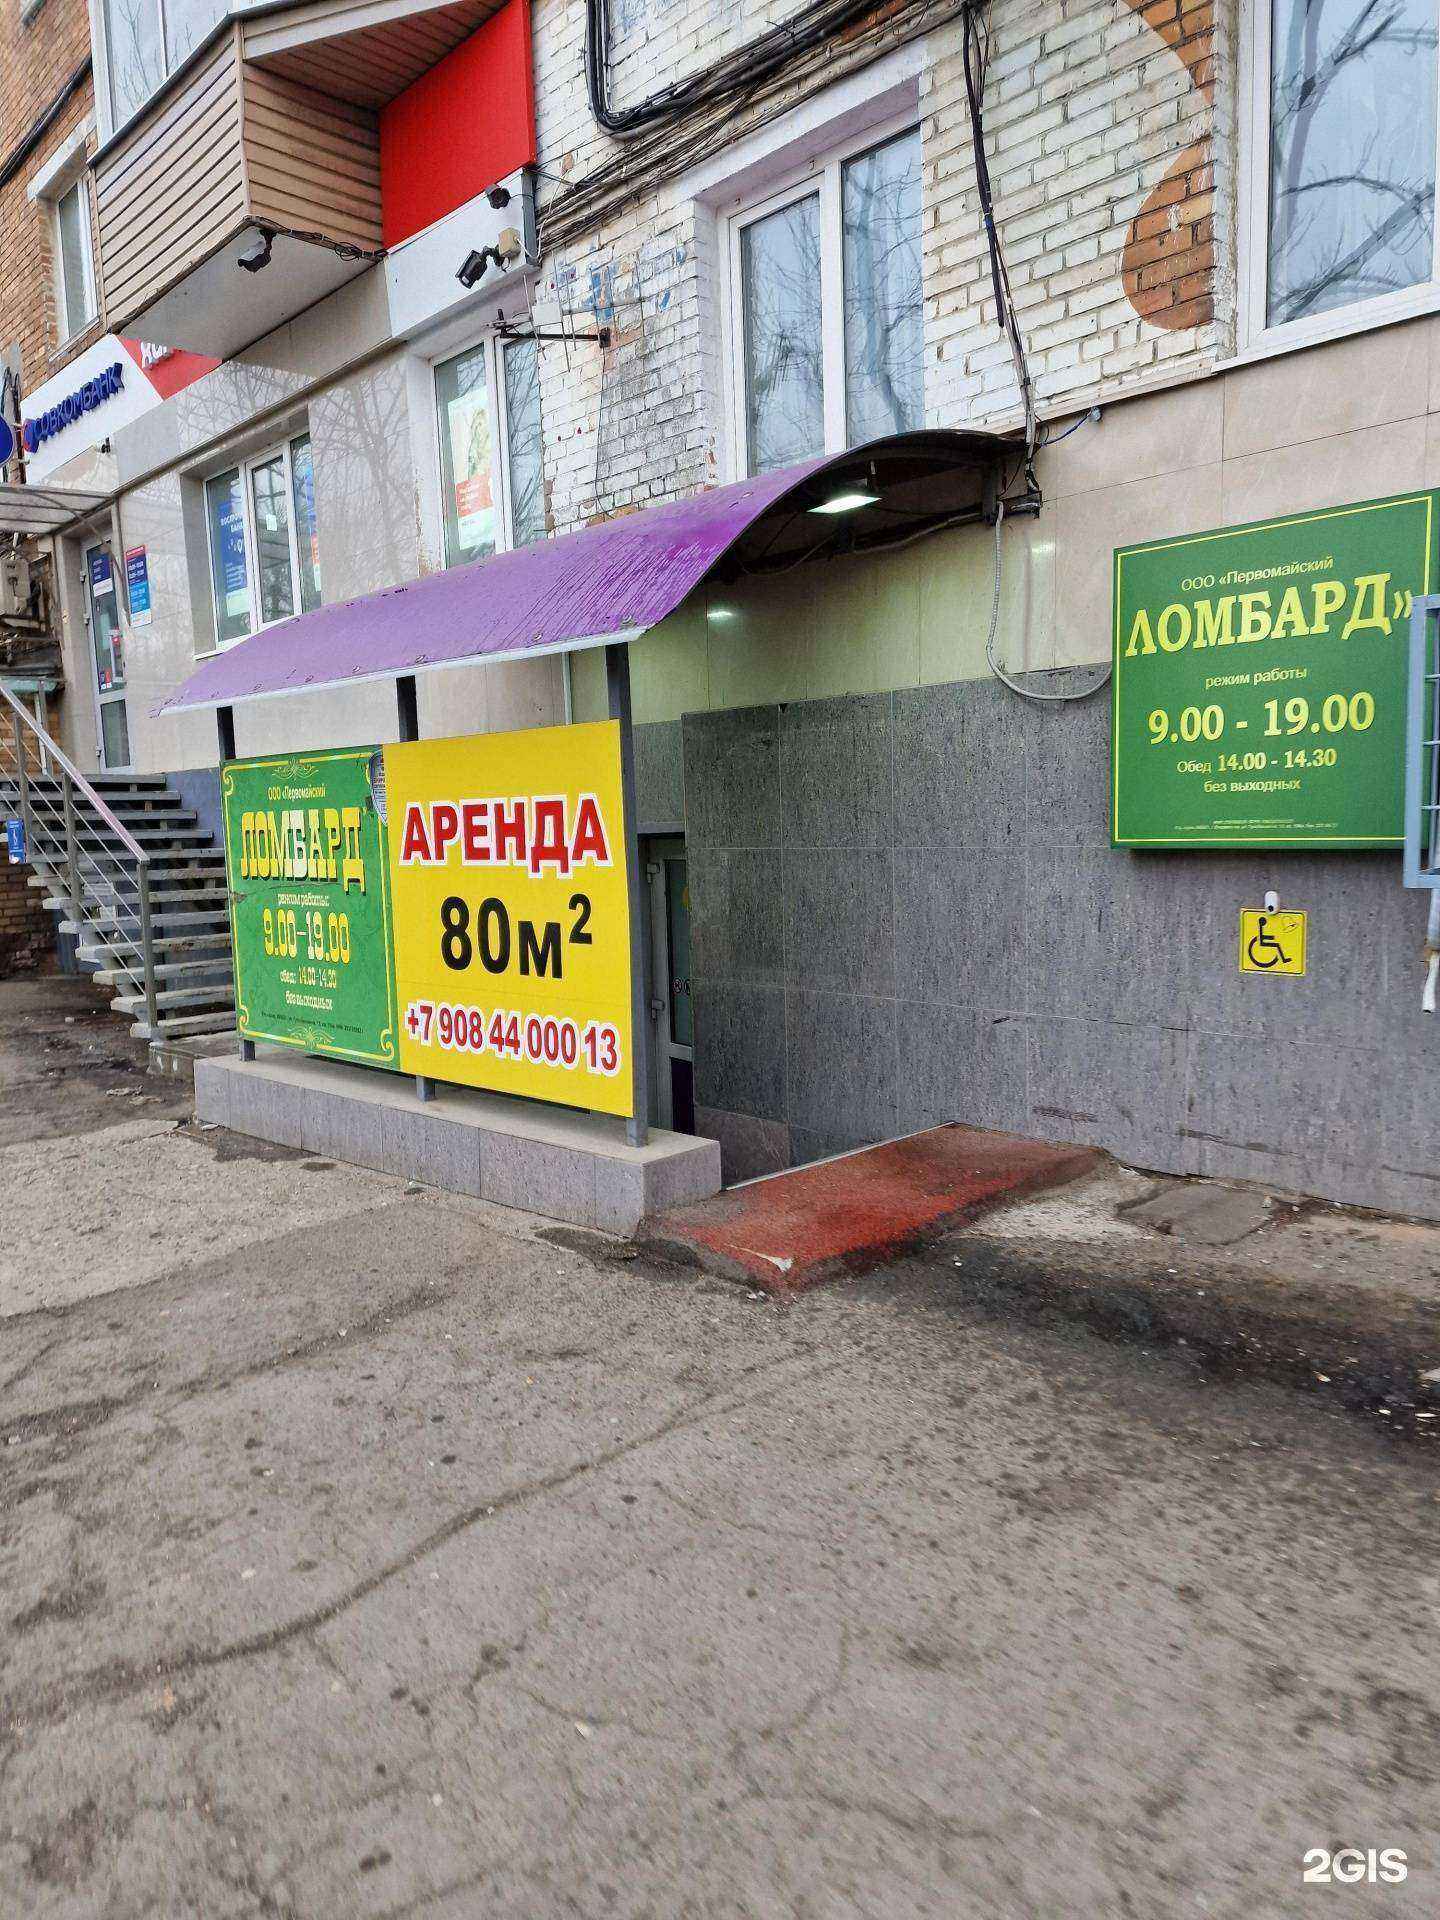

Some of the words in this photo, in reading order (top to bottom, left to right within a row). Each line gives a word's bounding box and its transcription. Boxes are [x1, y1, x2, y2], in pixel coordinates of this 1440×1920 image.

[1181, 574, 1215, 592] ООО
[1218, 555, 1334, 586] «Первомайский
[1124, 572, 1413, 657] ЛОМБАРД»
[1204, 673, 1250, 690] режим
[1253, 667, 1308, 686] работы
[1148, 704, 1225, 745] 9.00
[1263, 691, 1376, 737] 19.00
[1176, 759, 1212, 775] Обед
[1217, 751, 1267, 772] 14.00
[1284, 748, 1338, 769] 14.30
[267, 786, 281, 800] ООО
[1203, 780, 1227, 793] без
[1230, 777, 1302, 793] выходных
[401, 796, 611, 877] АРЕНДА
[407, 1003, 434, 1042] +7
[438, 1006, 484, 1051] 908
[488, 1013, 522, 1056] 44
[526, 1018, 577, 1065] 000
[584, 1026, 619, 1072] 13
